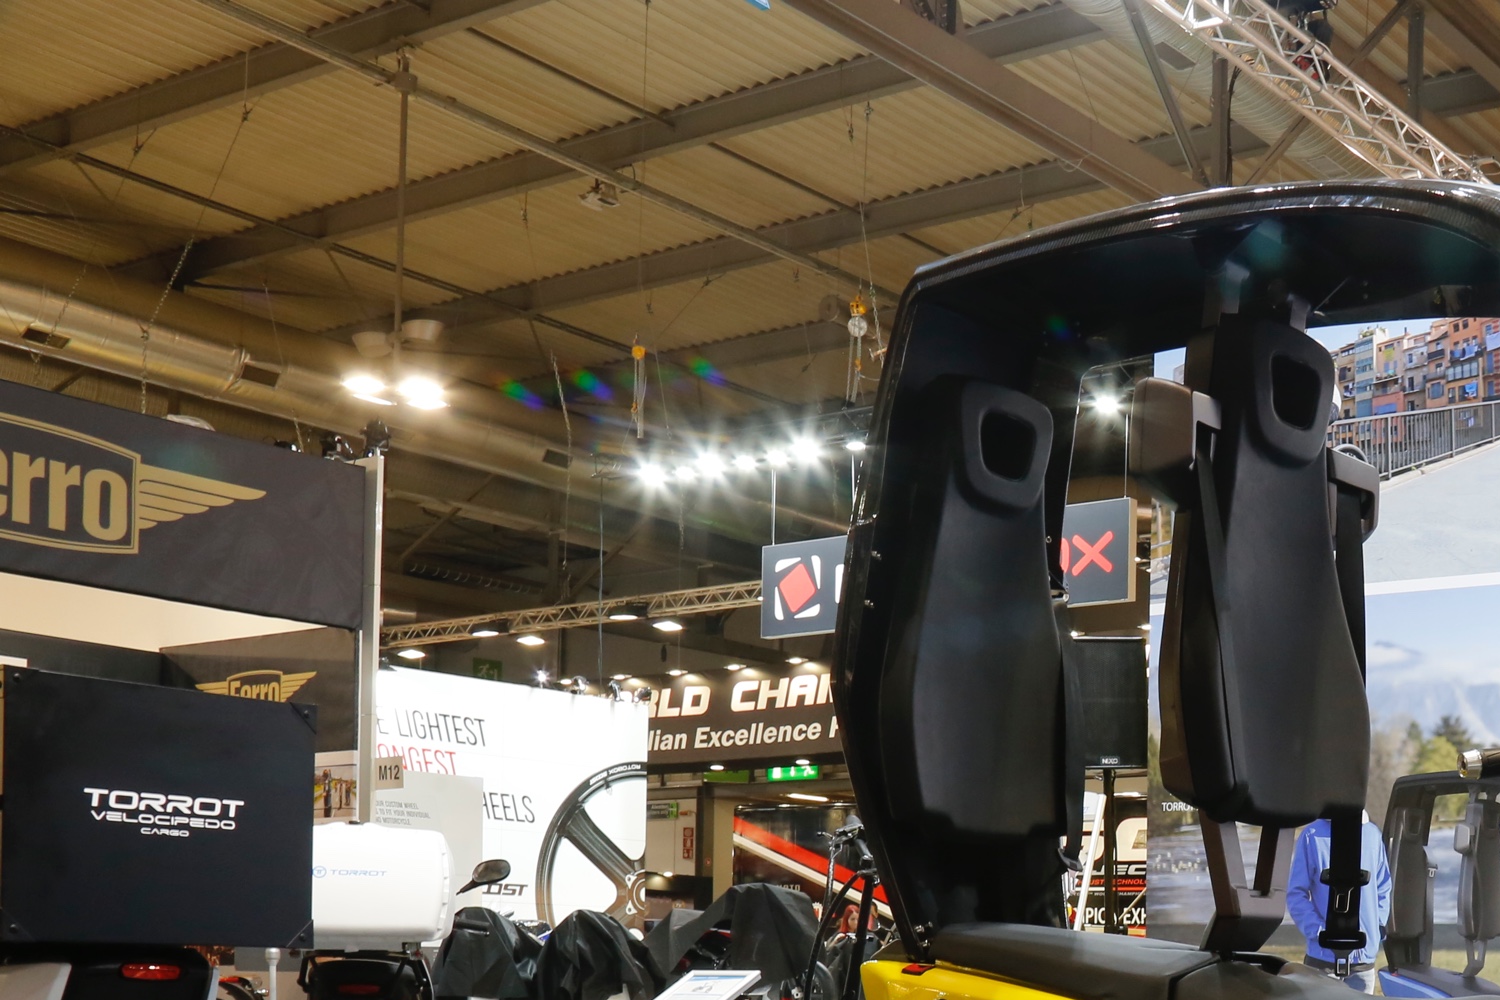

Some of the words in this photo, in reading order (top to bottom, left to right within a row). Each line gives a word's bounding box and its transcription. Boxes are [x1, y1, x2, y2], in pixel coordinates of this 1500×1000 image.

[0, 448, 127, 541] rro
[395, 708, 486, 747] LIGHTEST
[694, 722, 821, 748] Excellence
[378, 765, 400, 780] M12
[84, 787, 245, 818] TORROT
[90, 810, 236, 830] VELOCIPEDO
[140, 827, 190, 837] CARGO
[330, 869, 387, 877] TORROT
